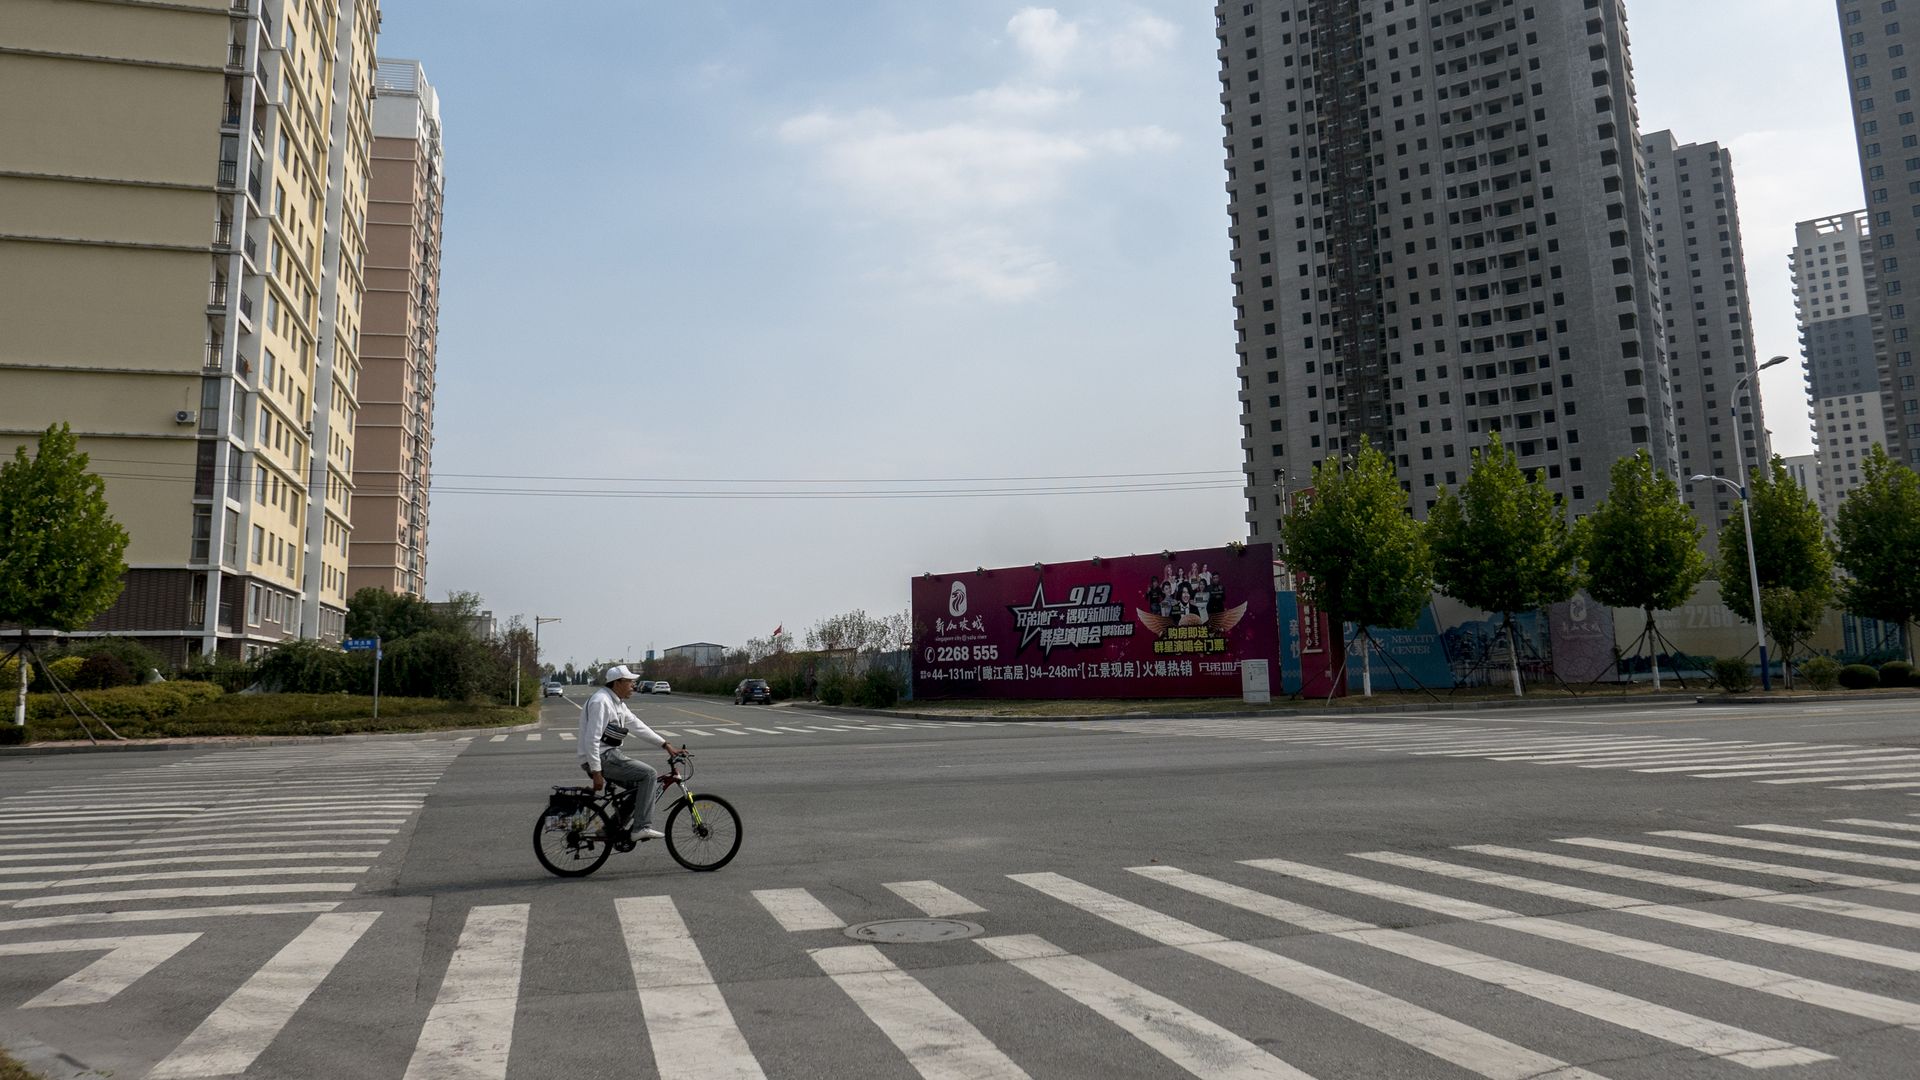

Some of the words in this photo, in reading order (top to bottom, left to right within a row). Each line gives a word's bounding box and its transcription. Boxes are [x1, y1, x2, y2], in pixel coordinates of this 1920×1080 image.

[1070, 586, 1110, 605] 9.13
[1016, 610, 1059, 627] 兄弟地产
[1066, 605, 1122, 624] 遇见新加坡
[1040, 626, 1101, 648] 群星演唱会
[1167, 626, 1209, 639] 购房即送
[937, 646, 970, 662] 2268
[973, 645, 998, 661] 555
[1154, 638, 1225, 653] 群星演唱会门票
